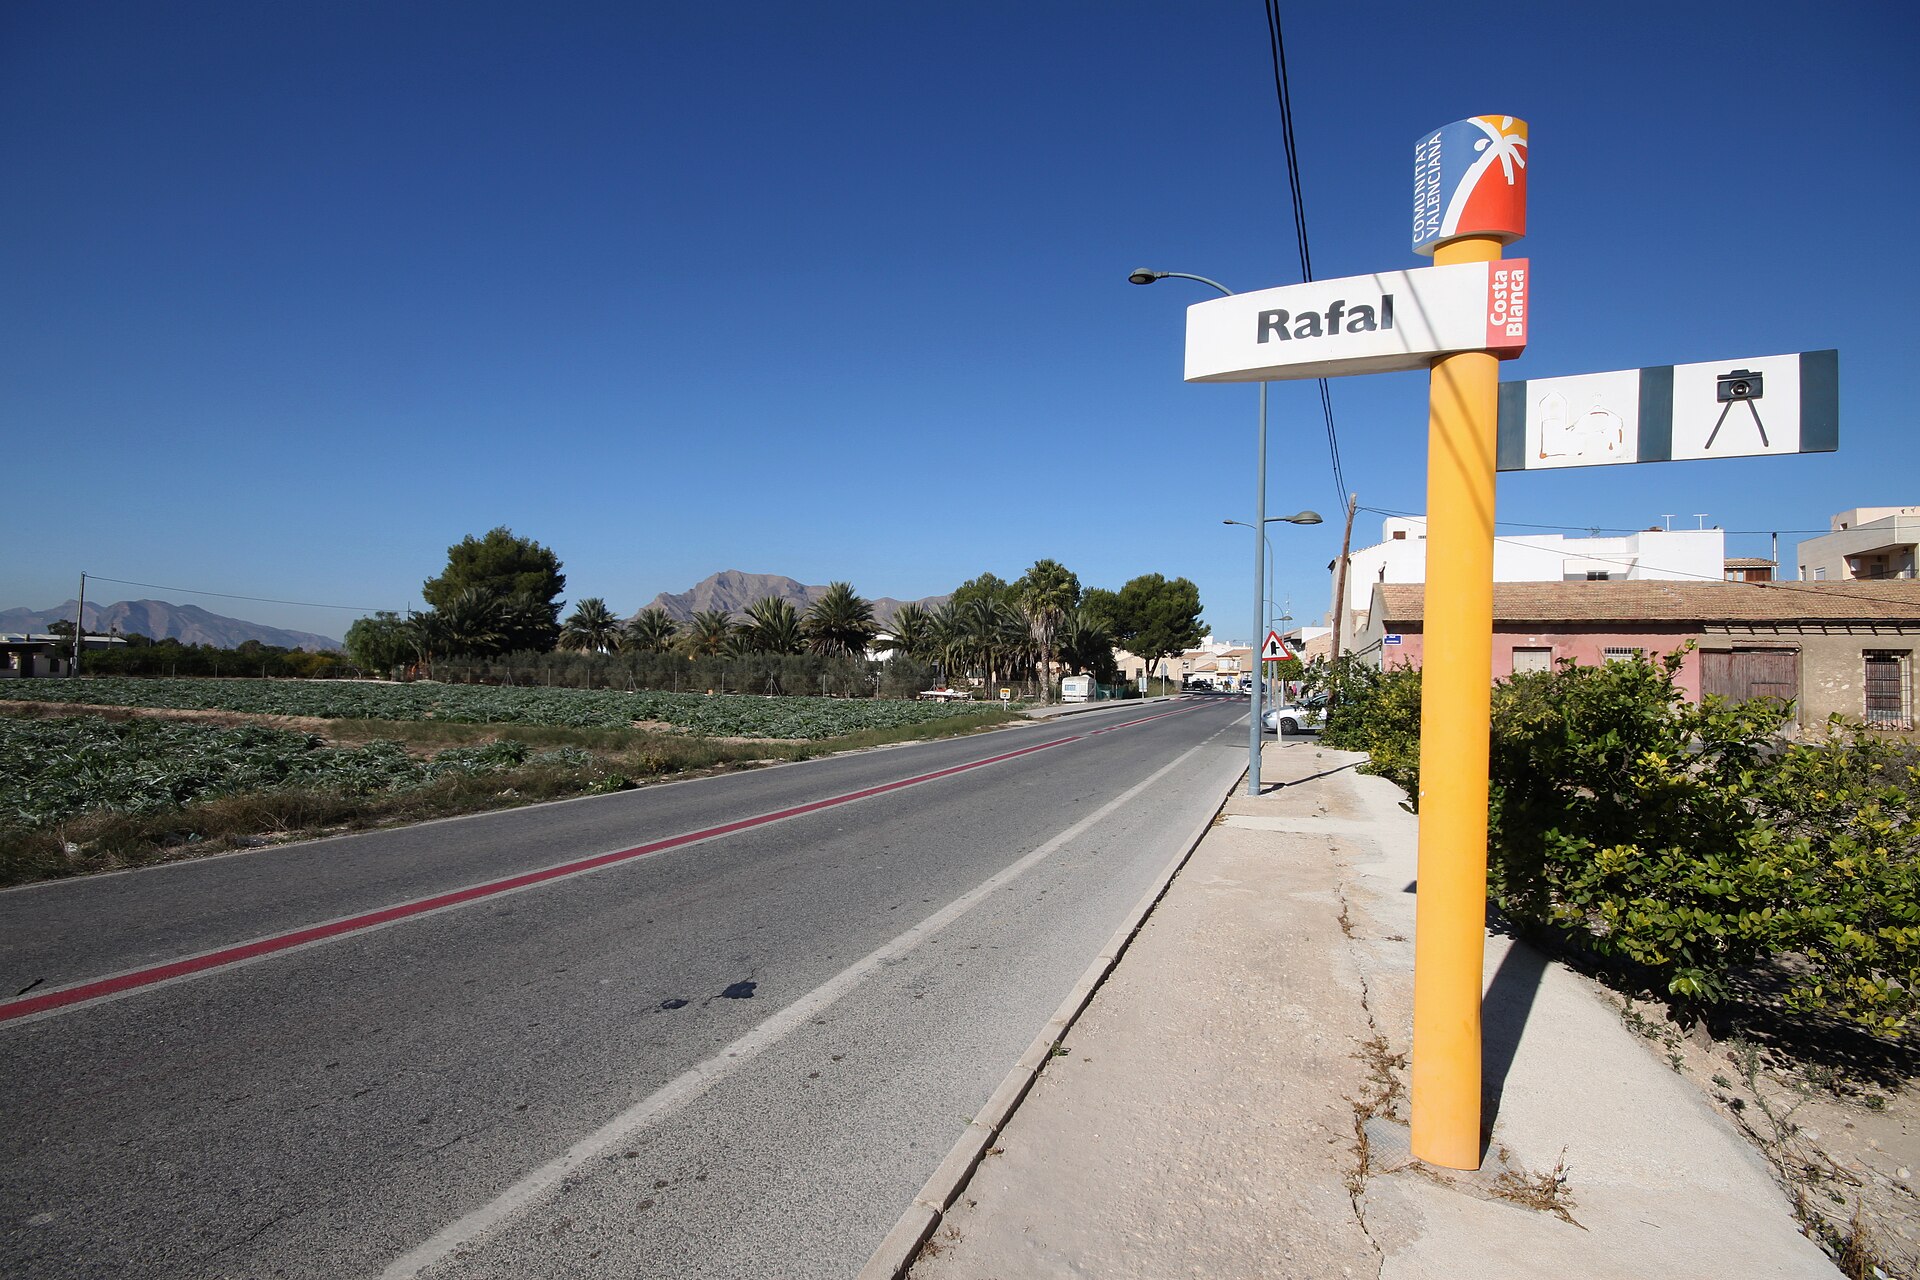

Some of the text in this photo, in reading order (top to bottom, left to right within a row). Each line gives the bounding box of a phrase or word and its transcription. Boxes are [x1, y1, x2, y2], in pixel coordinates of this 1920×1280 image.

[1413, 143, 1426, 243] COMUNITAT
[1426, 132, 1441, 238] VALENCIANA
[1257, 294, 1393, 344] Rafal
[1490, 270, 1507, 326] Costa
[1507, 269, 1524, 337] Blanca
